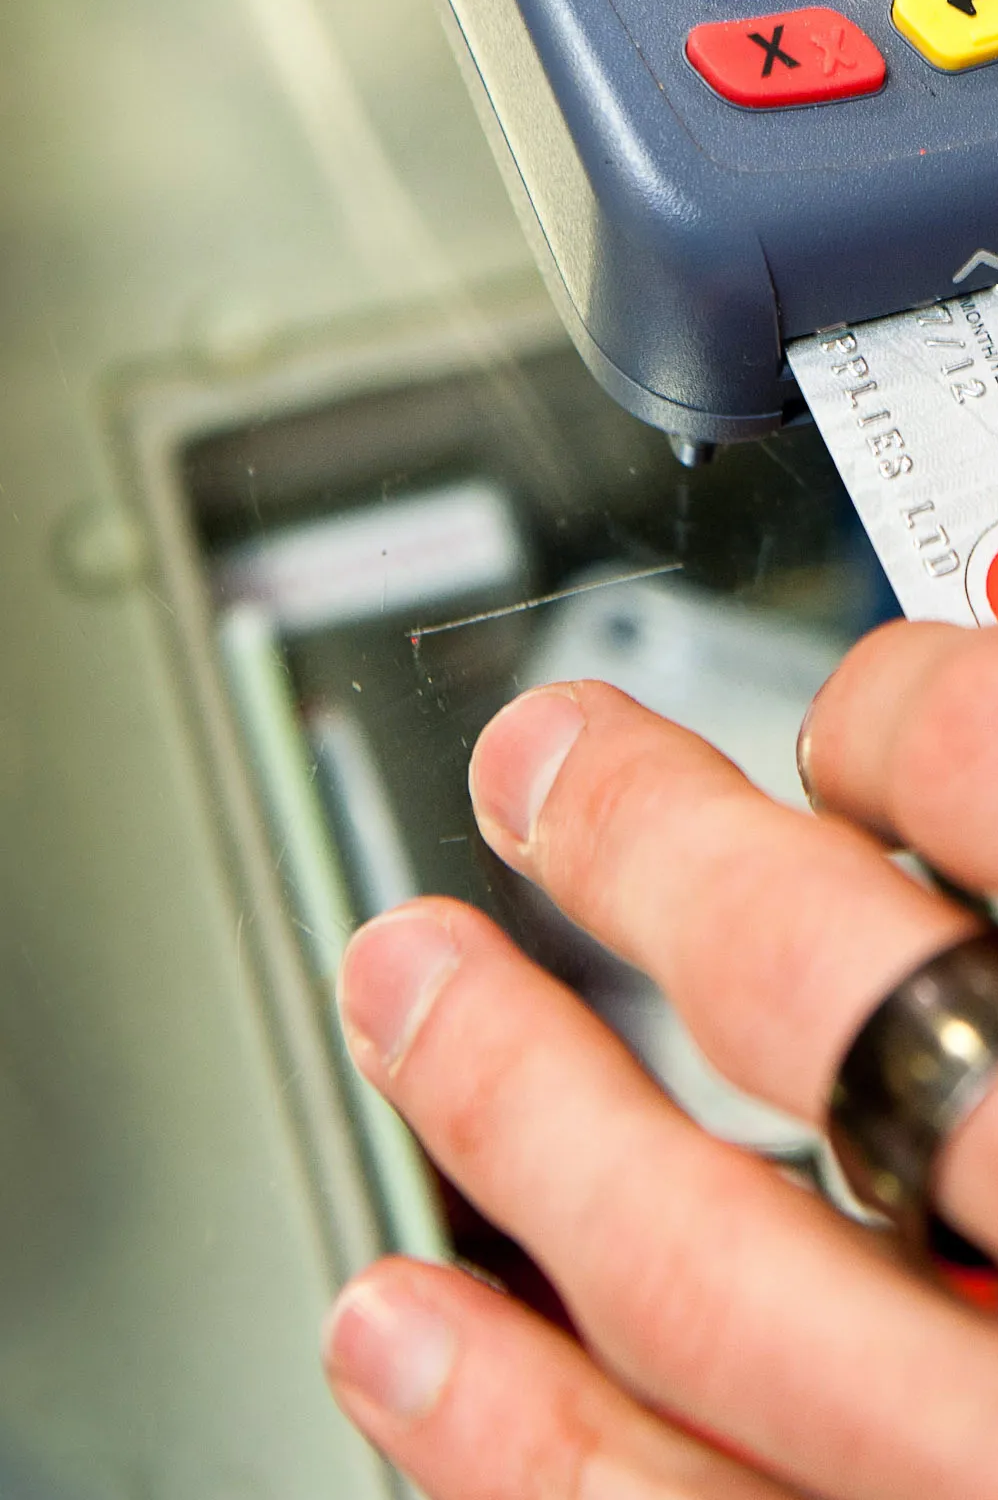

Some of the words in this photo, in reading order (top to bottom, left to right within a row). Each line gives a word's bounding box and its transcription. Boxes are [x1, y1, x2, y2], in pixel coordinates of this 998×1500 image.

[916, 299, 986, 405] 7/12
[816, 323, 914, 480] PPLIES
[903, 500, 961, 579] LTD
